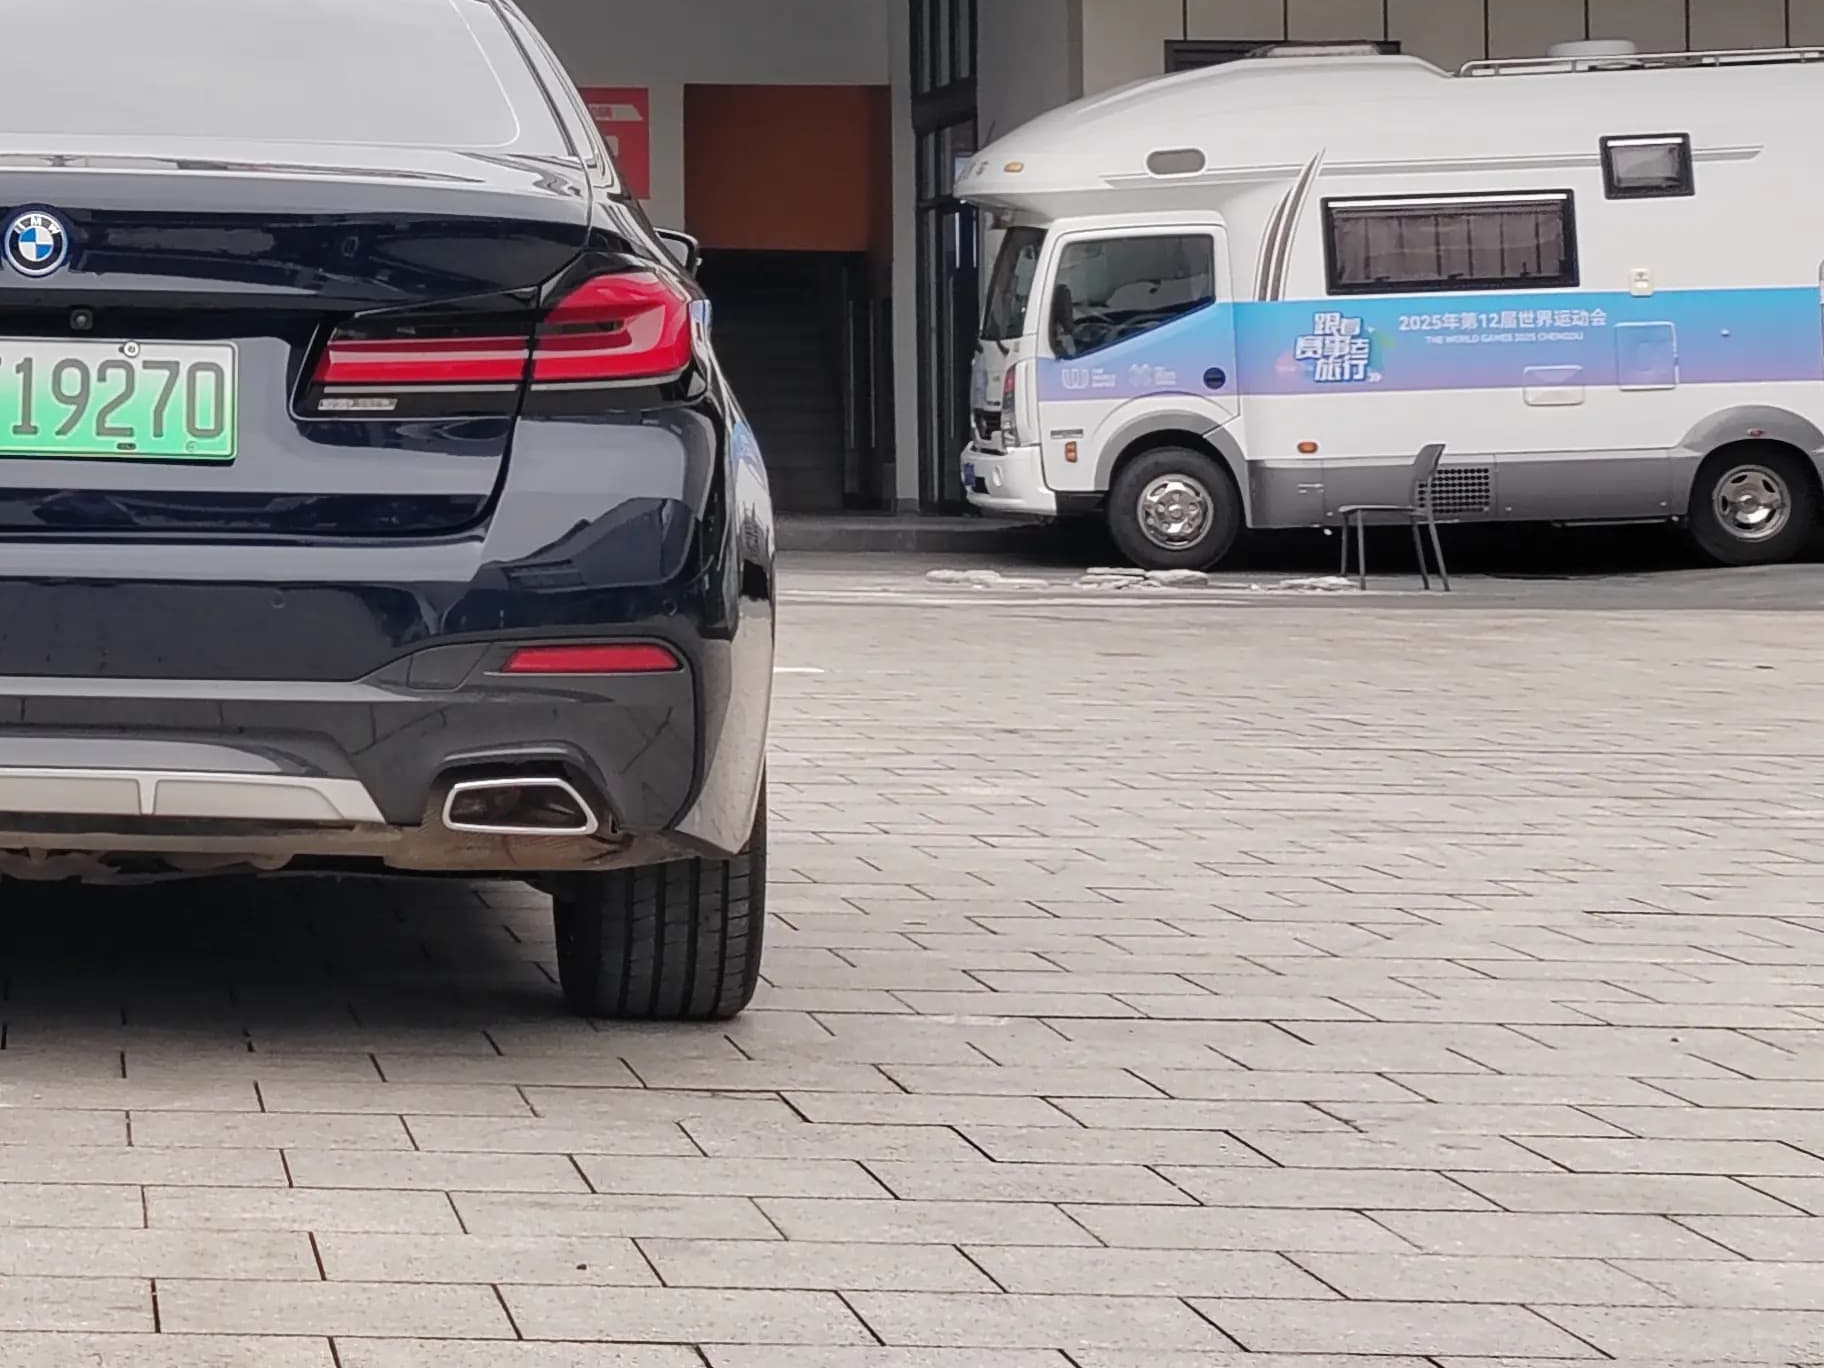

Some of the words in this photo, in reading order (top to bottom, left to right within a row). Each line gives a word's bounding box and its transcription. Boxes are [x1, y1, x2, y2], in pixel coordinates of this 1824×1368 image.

[14, 216, 61, 234] BMW
[1399, 308, 1607, 330] 2025年第12届世界运动会
[1314, 356, 1368, 381] 旅行
